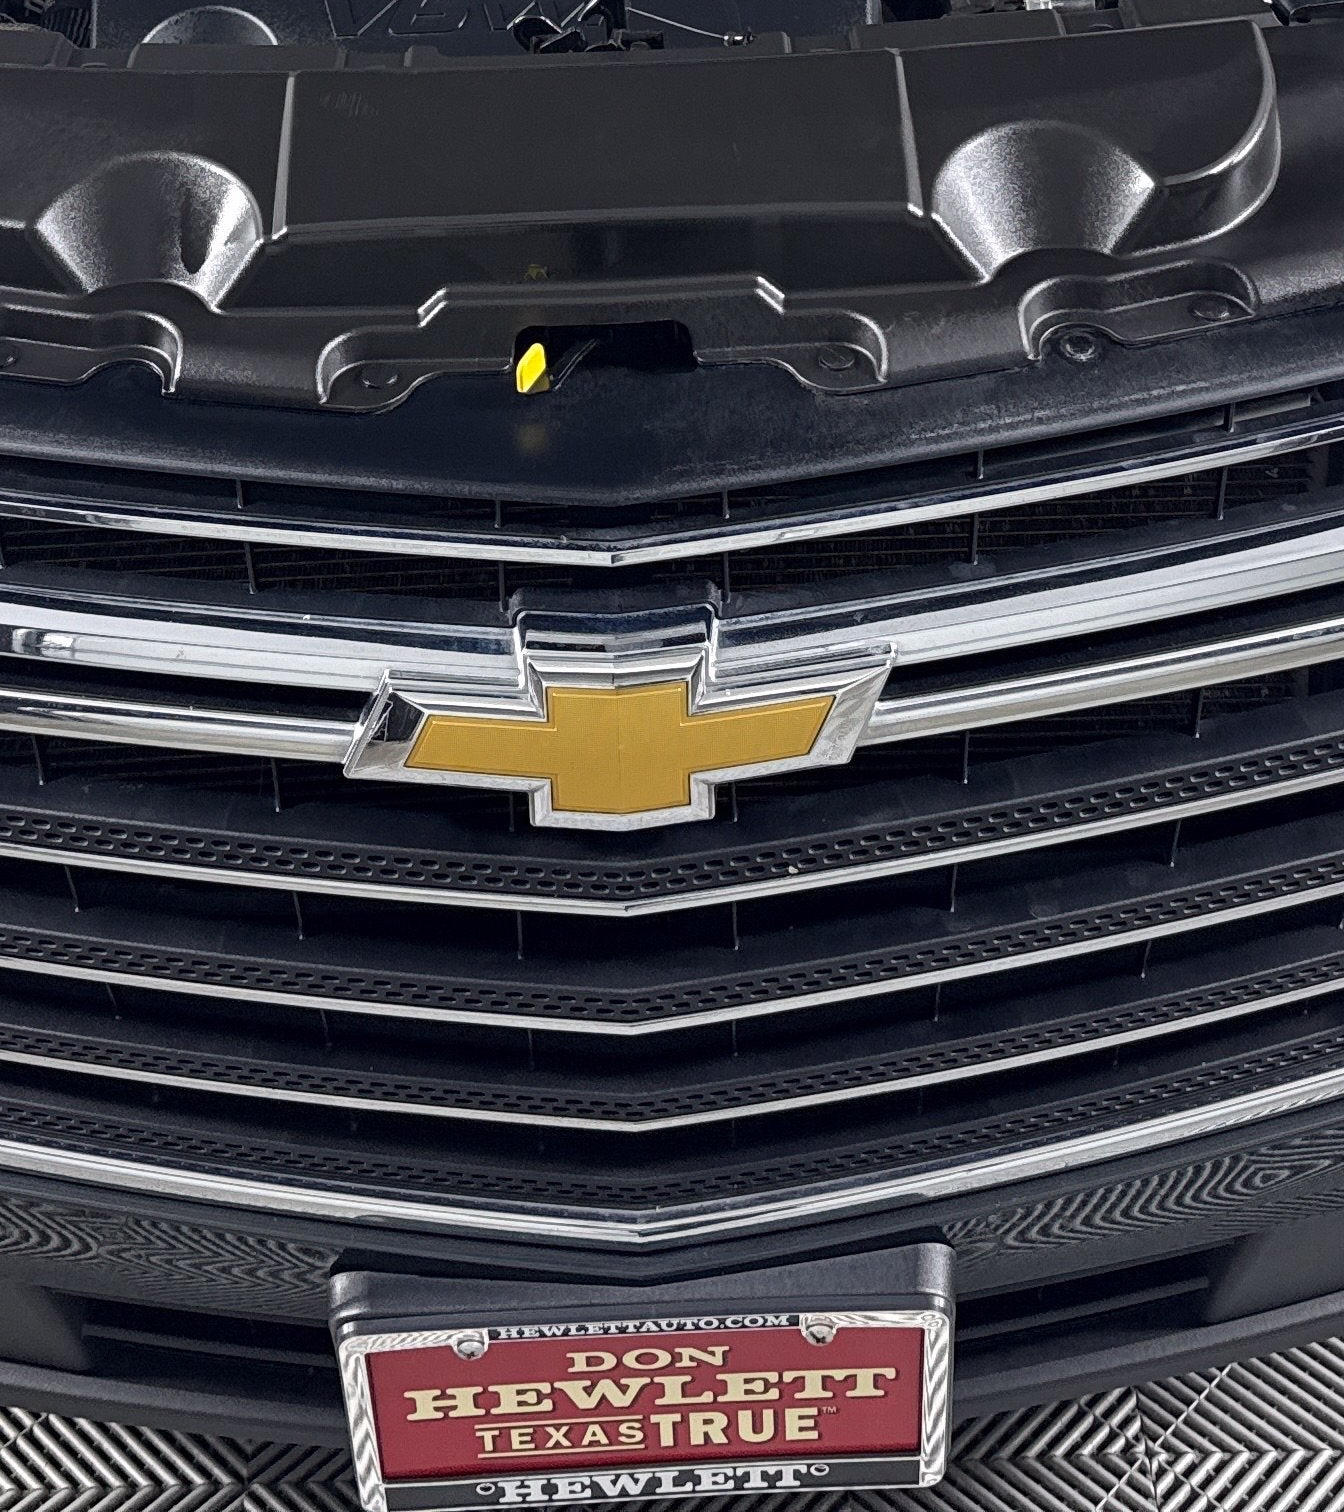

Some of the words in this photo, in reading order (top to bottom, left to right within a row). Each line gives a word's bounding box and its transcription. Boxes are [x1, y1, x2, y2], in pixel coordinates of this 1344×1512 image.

[498, 1314, 790, 1339] HEWLETTAUTO.COM
[565, 1345, 730, 1373] DON
[403, 1366, 897, 1421] HEWLETT
[498, 1463, 807, 1503] HEWLETT
